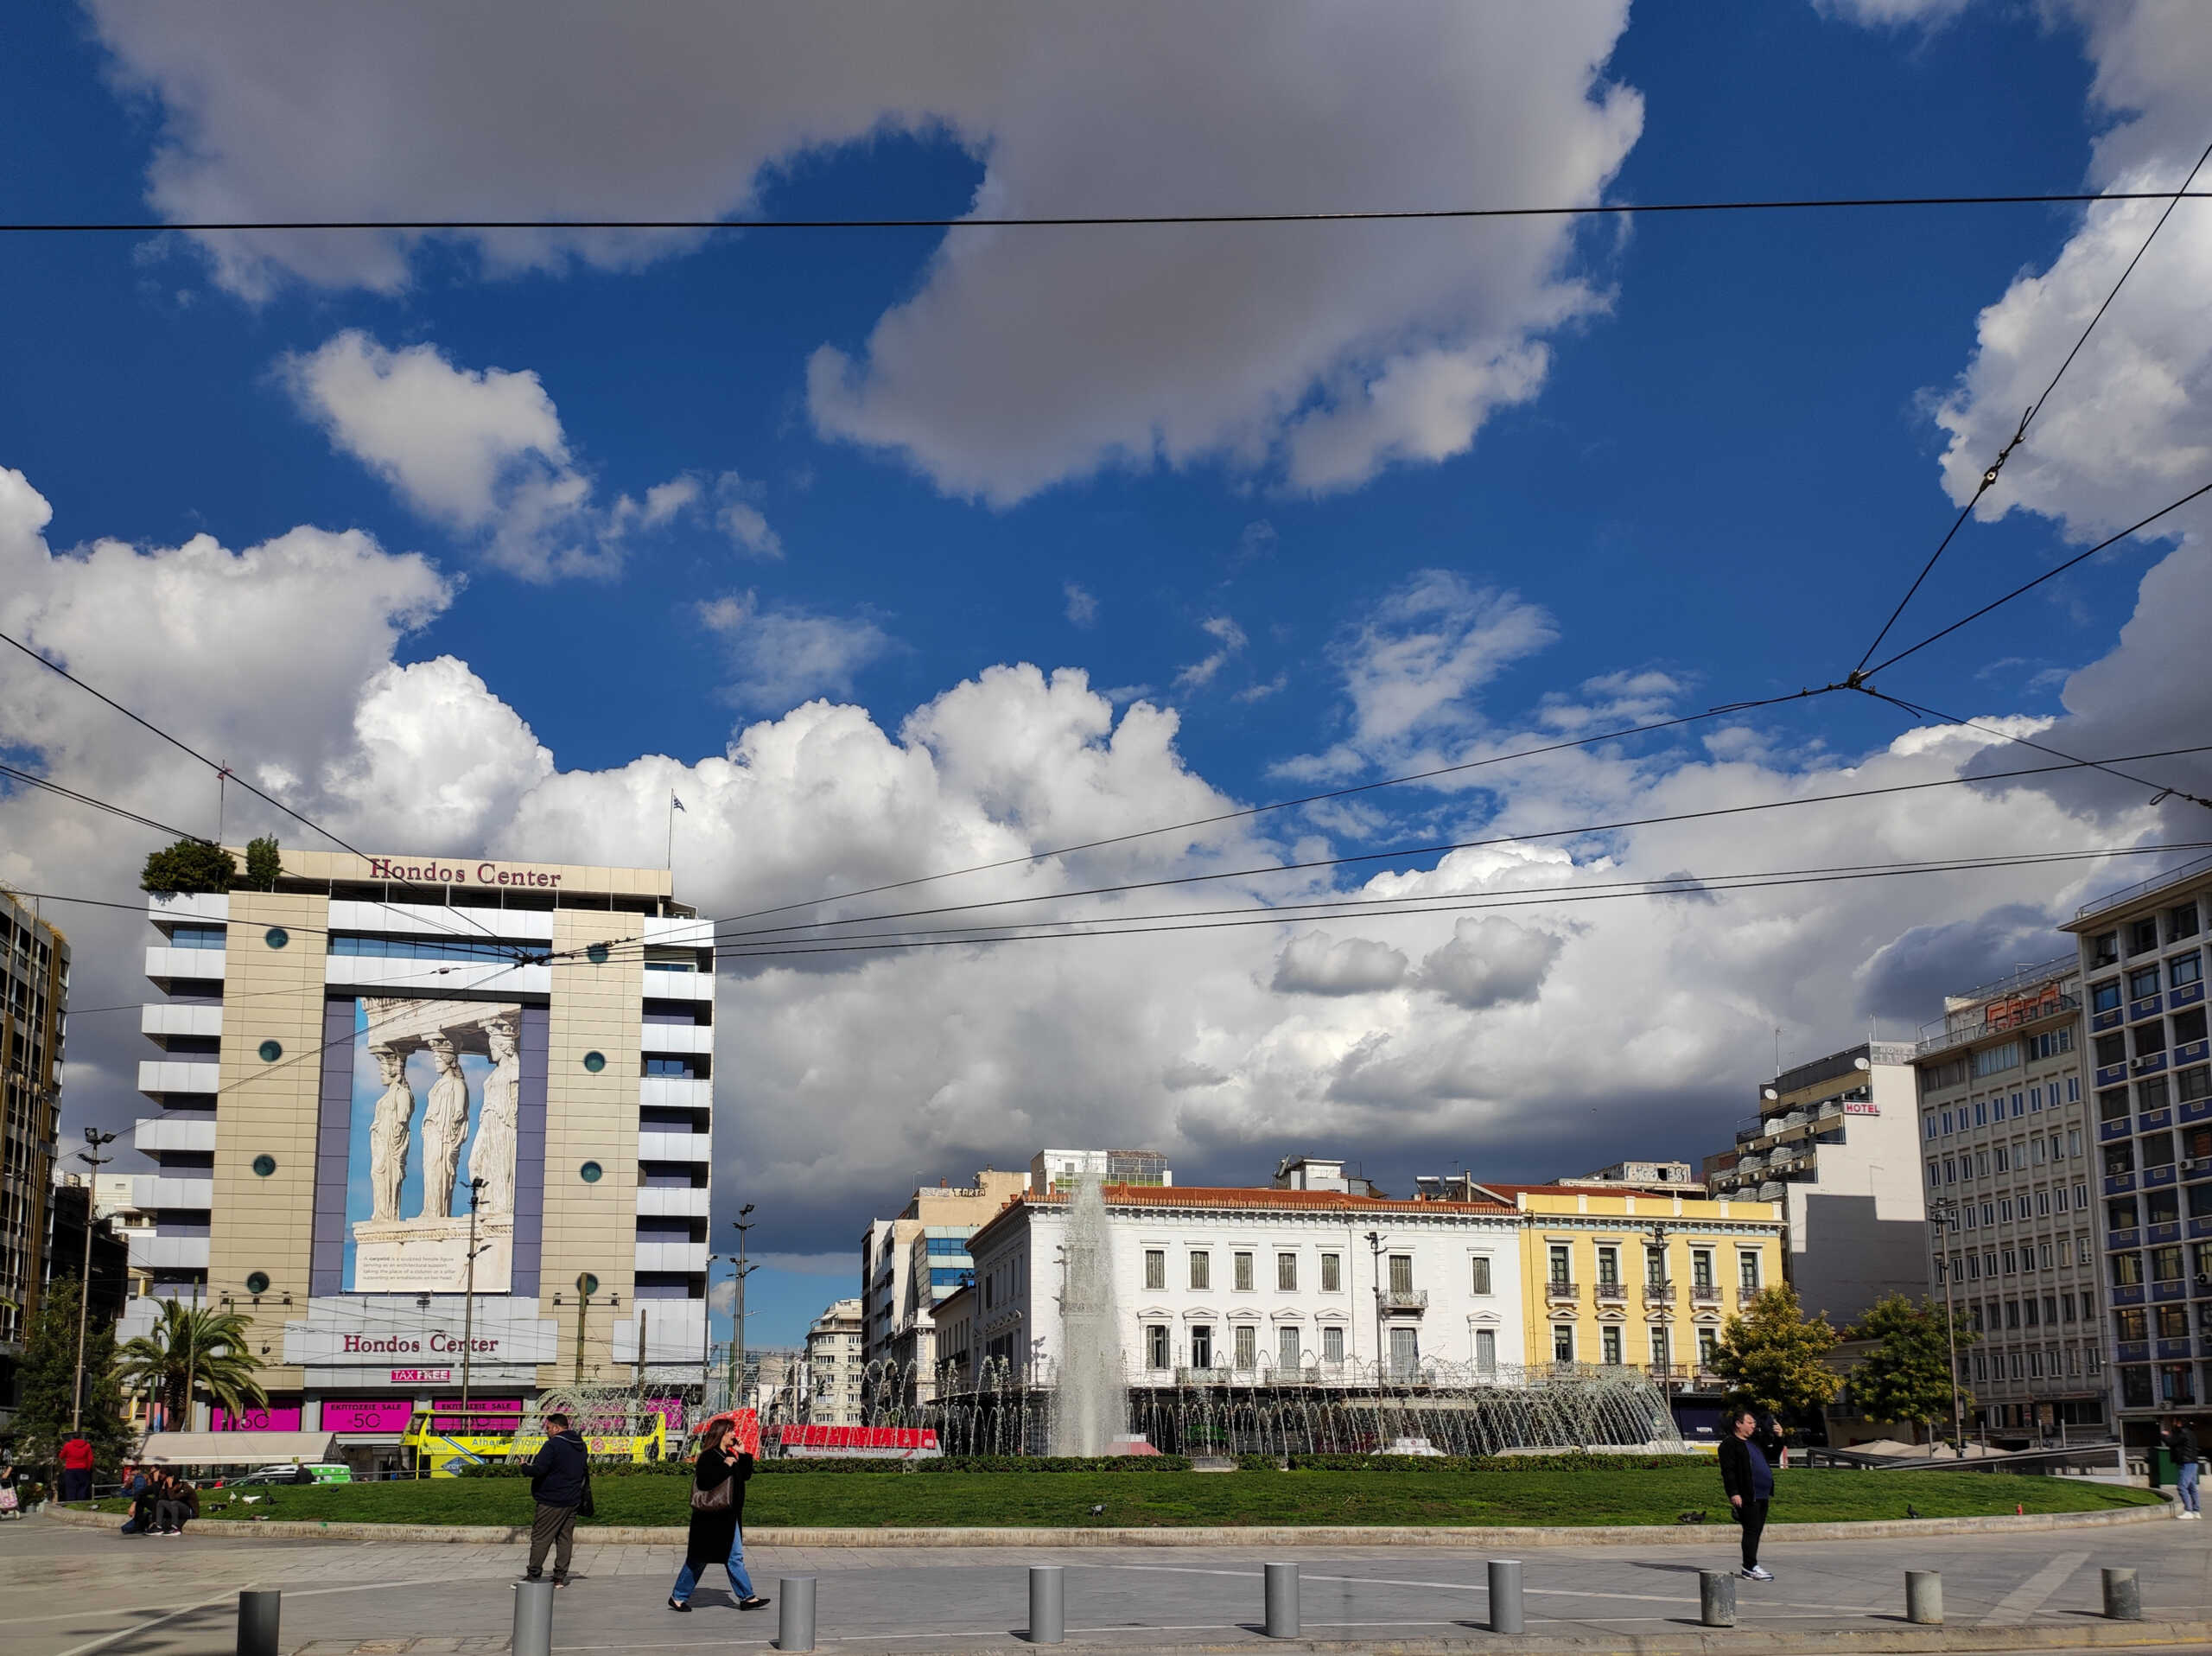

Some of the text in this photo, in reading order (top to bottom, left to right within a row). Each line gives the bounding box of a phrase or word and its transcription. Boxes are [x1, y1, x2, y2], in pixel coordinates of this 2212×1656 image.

[369, 858, 561, 887] Hondos Center
[1846, 1104, 1881, 1113] HOTEL
[343, 1334, 420, 1352] Hondos
[394, 1370, 449, 1379] TAX FREE
